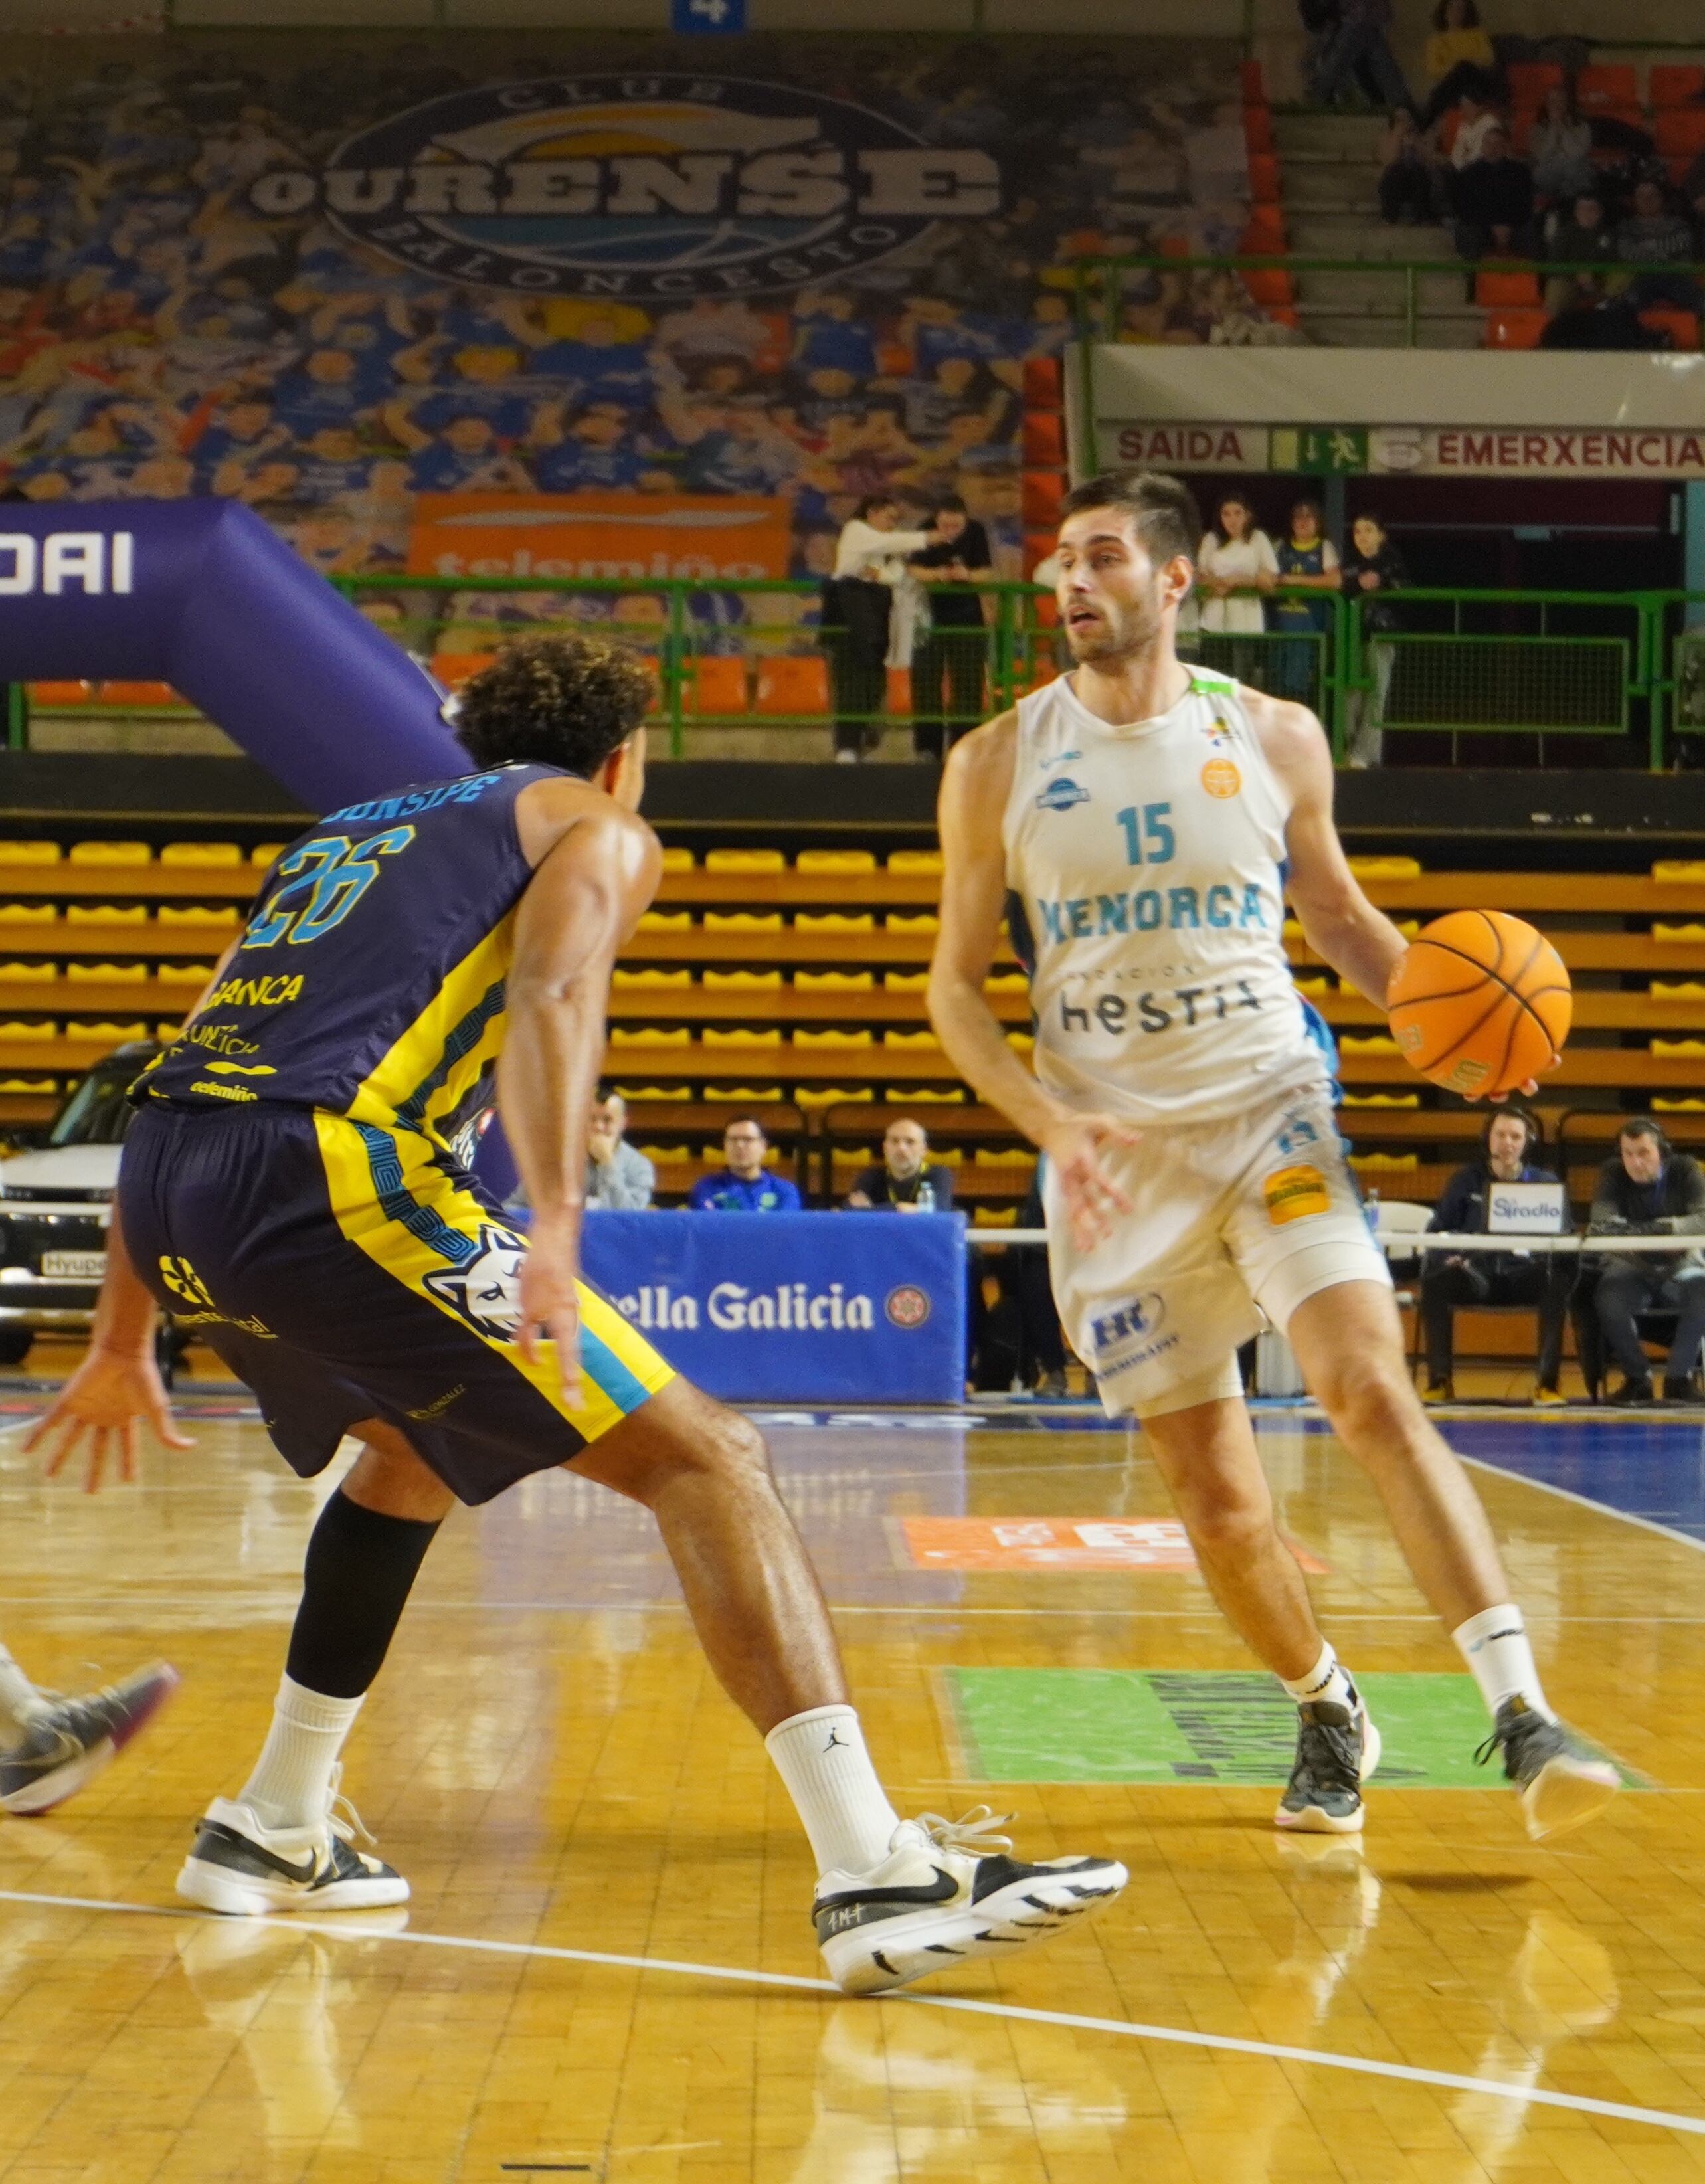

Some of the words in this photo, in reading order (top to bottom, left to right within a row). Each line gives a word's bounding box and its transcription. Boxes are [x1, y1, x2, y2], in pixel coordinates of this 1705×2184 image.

[497, 77, 724, 110] CLUB
[250, 148, 1002, 217] OURENSE
[369, 222, 898, 294] BALONCESTO
[1117, 428, 1244, 462] SAIDA
[1437, 432, 1705, 469] EMERXENCIA
[1117, 802, 1177, 865] 15
[239, 824, 416, 950] 26
[1037, 883, 1267, 945] MENORCA
[707, 1282, 875, 1330] Galicia
